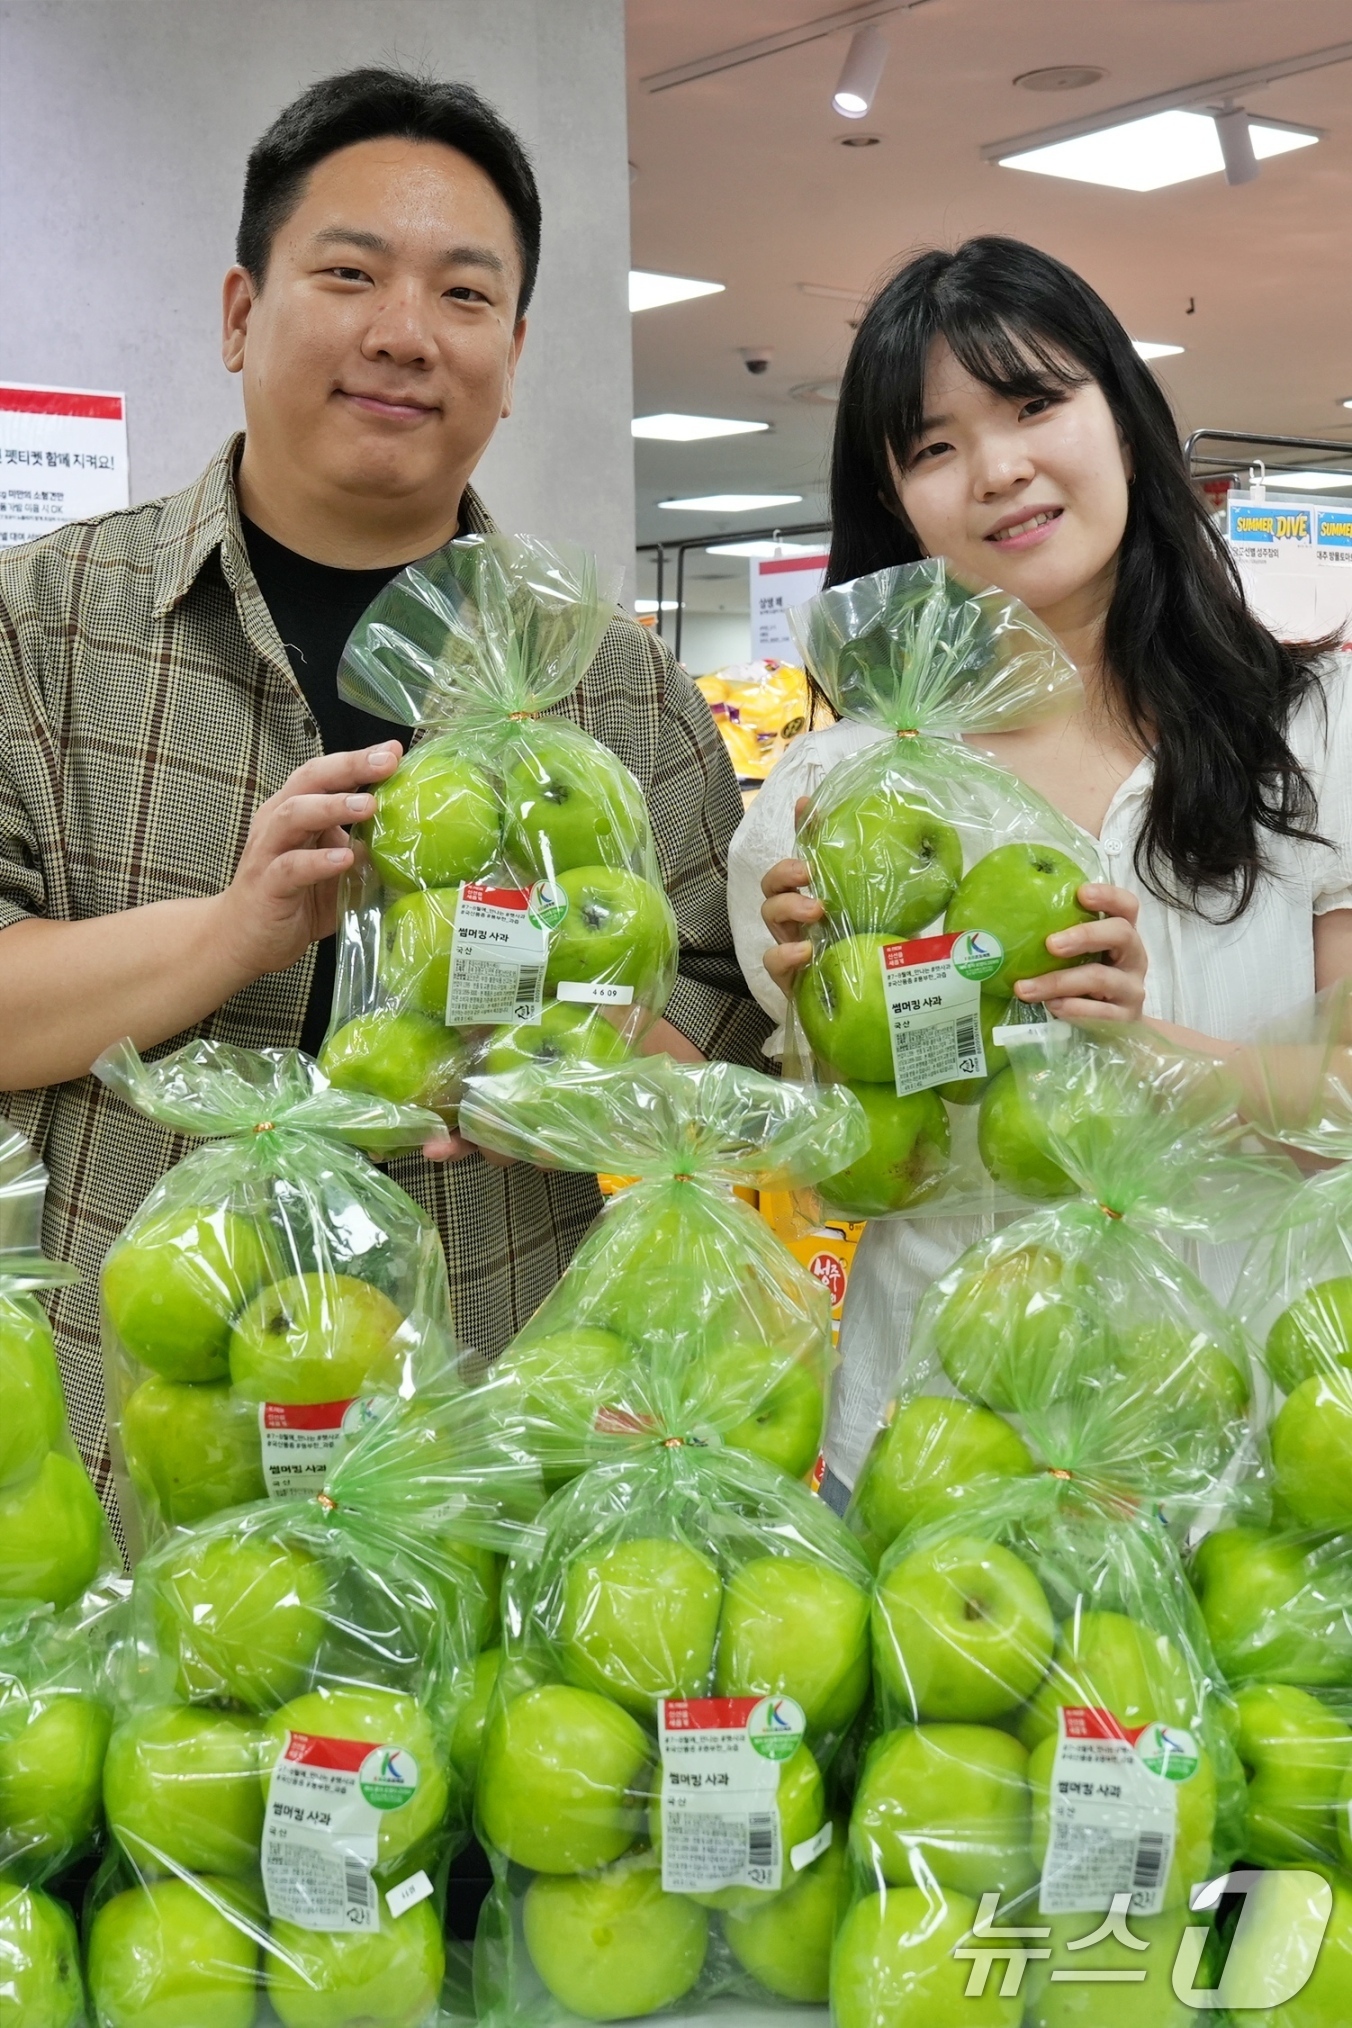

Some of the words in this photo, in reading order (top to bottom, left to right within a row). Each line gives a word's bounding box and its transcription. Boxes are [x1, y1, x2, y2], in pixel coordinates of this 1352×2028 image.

[4, 449, 43, 466] 펫티켓
[45, 451, 70, 468] 함께
[73, 453, 115, 471] 지켜요!
[1237, 516, 1273, 533] SUMMER
[1275, 513, 1308, 538] DIVE
[1320, 521, 1352, 538] SUMME
[1316, 550, 1328, 560] 대추
[1329, 551, 1352, 562] 방울토마
[458, 927, 487, 940] 썸머킹
[489, 932, 509, 942] 사과
[456, 945, 472, 955] 국산
[892, 999, 920, 1014] 썸머킹
[923, 996, 942, 1007] 사과
[894, 1020, 910, 1029] 국산
[814, 1257, 841, 1292] 성주
[269, 1464, 303, 1475] 썸머킹
[305, 1464, 327, 1473] 사과
[669, 1772, 702, 1787] 썸머킹
[705, 1773, 729, 1786] 사과
[1096, 1784, 1121, 1798] 사과
[273, 1801, 304, 1821] 썸머킹
[307, 1810, 331, 1825] 사과
